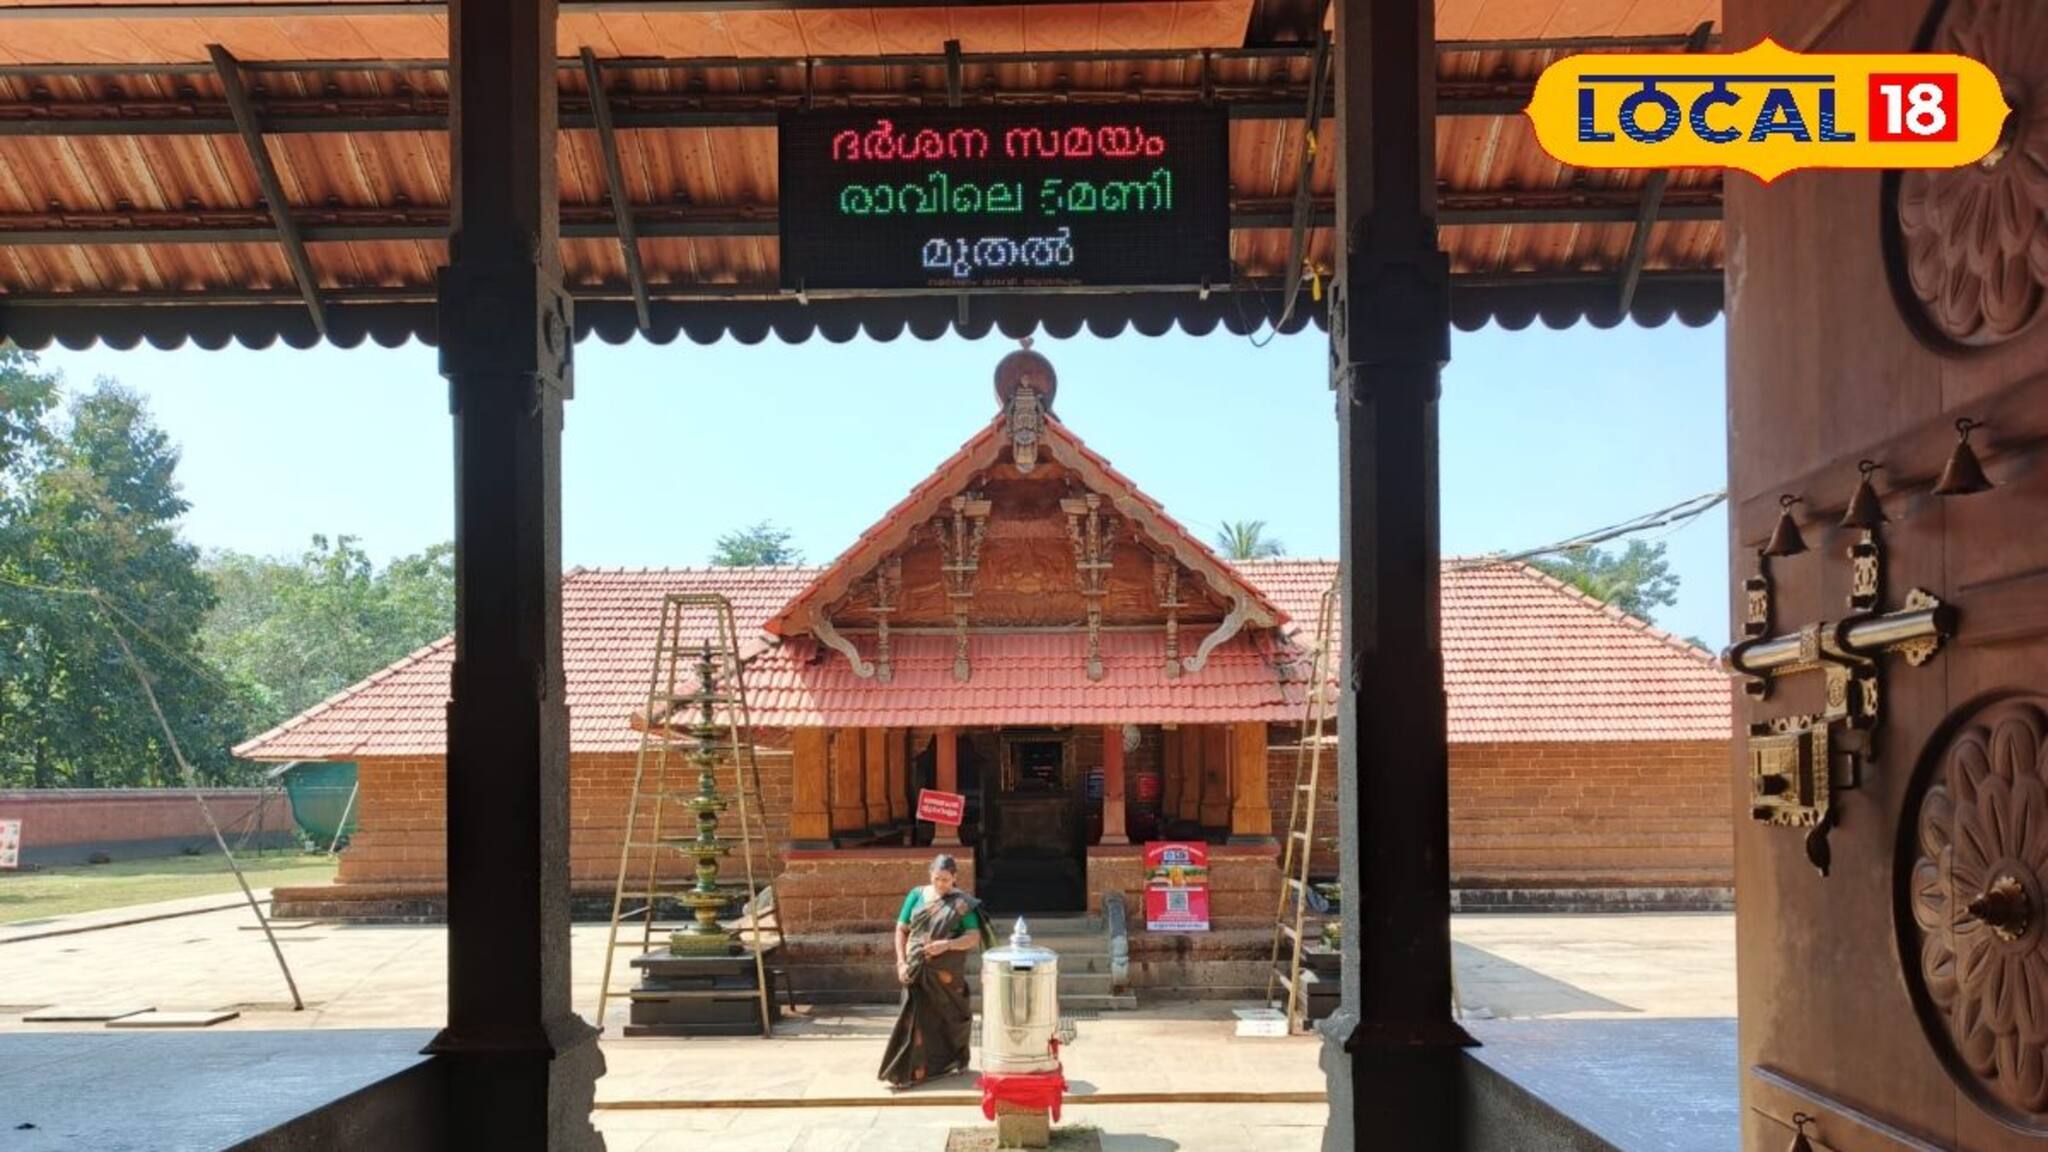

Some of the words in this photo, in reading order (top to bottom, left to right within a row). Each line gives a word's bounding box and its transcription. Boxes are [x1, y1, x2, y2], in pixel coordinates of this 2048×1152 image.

[832, 119, 988, 160] ദർശന
[1006, 126, 1165, 157] സമയം
[840, 170, 1023, 213] രാവിലെ
[922, 226, 1074, 277] മുതൽ
